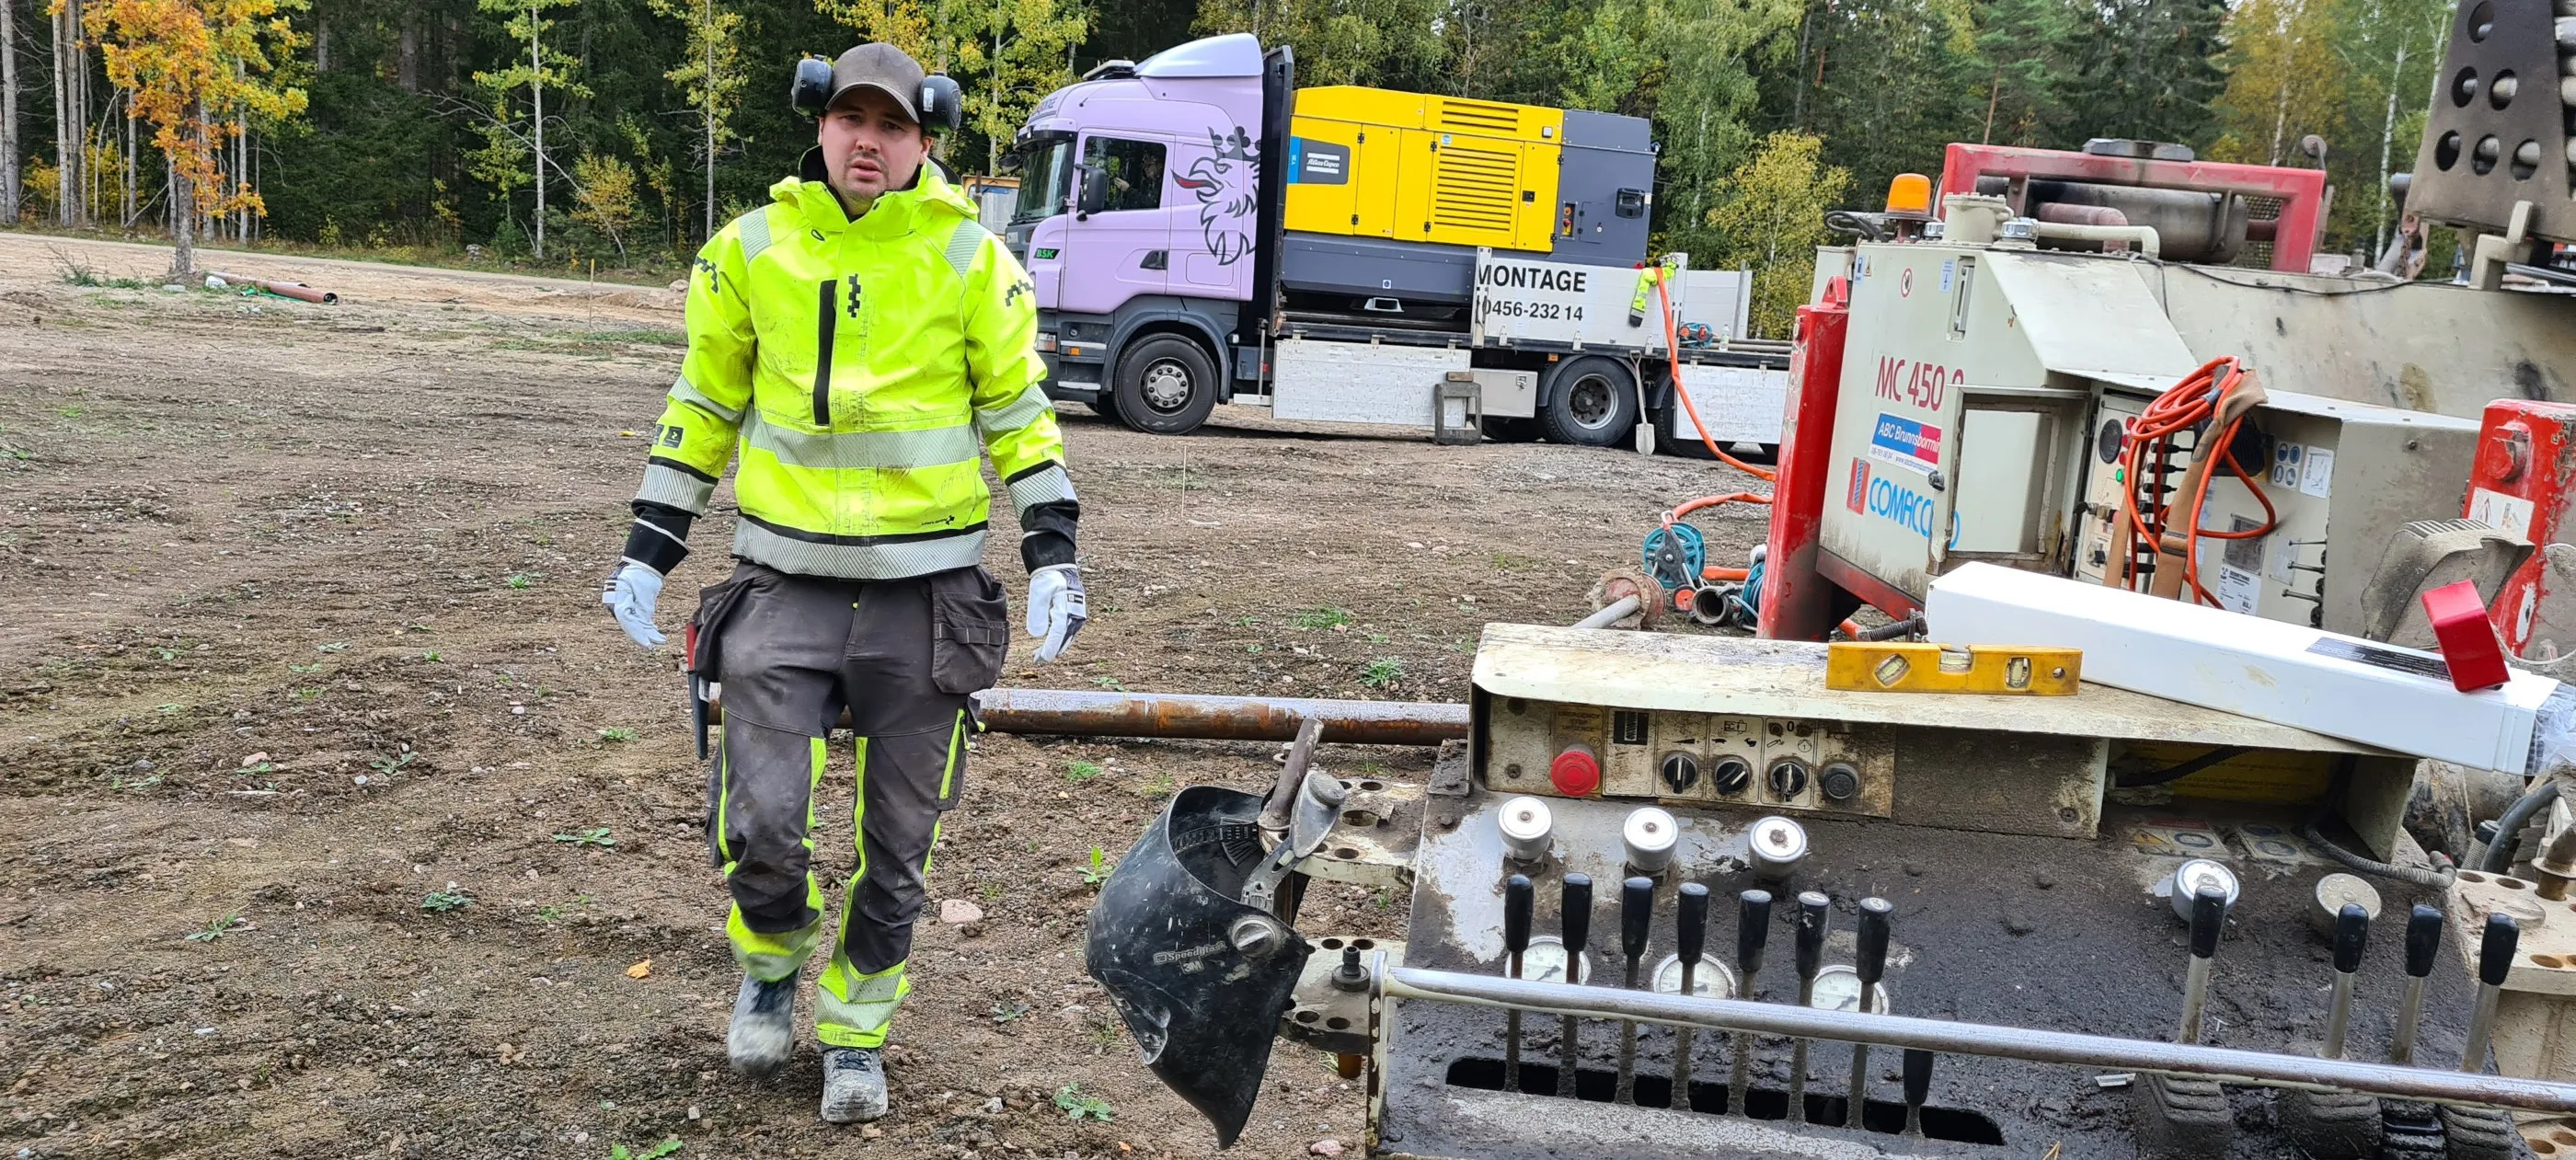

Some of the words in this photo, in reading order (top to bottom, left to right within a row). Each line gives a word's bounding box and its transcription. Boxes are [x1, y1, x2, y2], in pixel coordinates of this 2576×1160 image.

[1037, 249, 1055, 258] BSK
[1478, 264, 1587, 293] MONTAGE
[1564, 305, 1583, 321] 14
[1875, 355, 1905, 402] MC
[1907, 362, 1945, 411] 450
[1878, 421, 1895, 439] ABC
[1183, 960, 1203, 972] 3M
